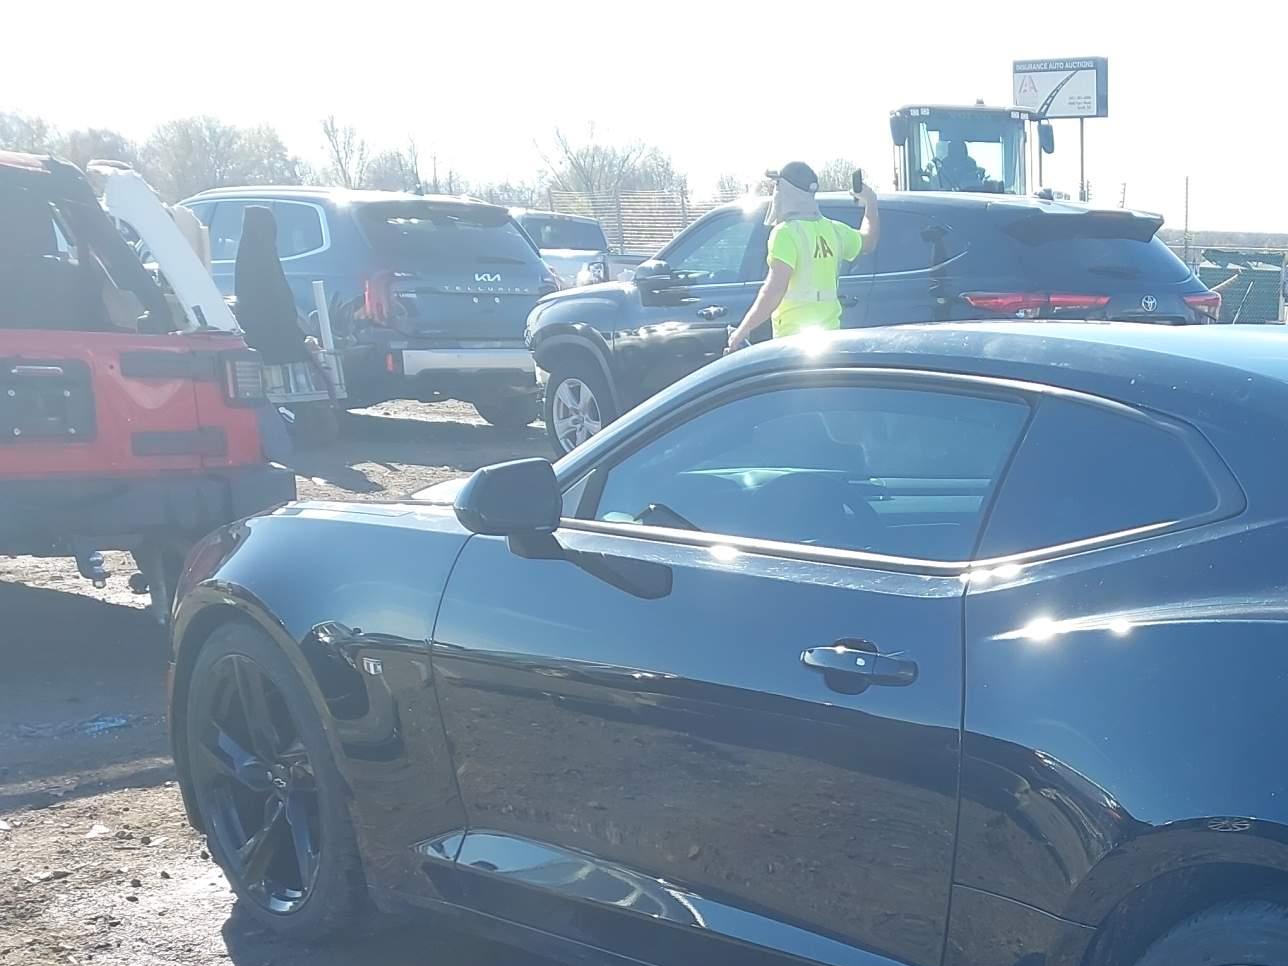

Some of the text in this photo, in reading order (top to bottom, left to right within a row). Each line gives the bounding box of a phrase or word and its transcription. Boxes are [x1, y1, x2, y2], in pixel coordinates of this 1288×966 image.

[1016, 60, 1094, 71] INSURANCE AUTO AUCTIONS
[474, 273, 501, 281] KIA
